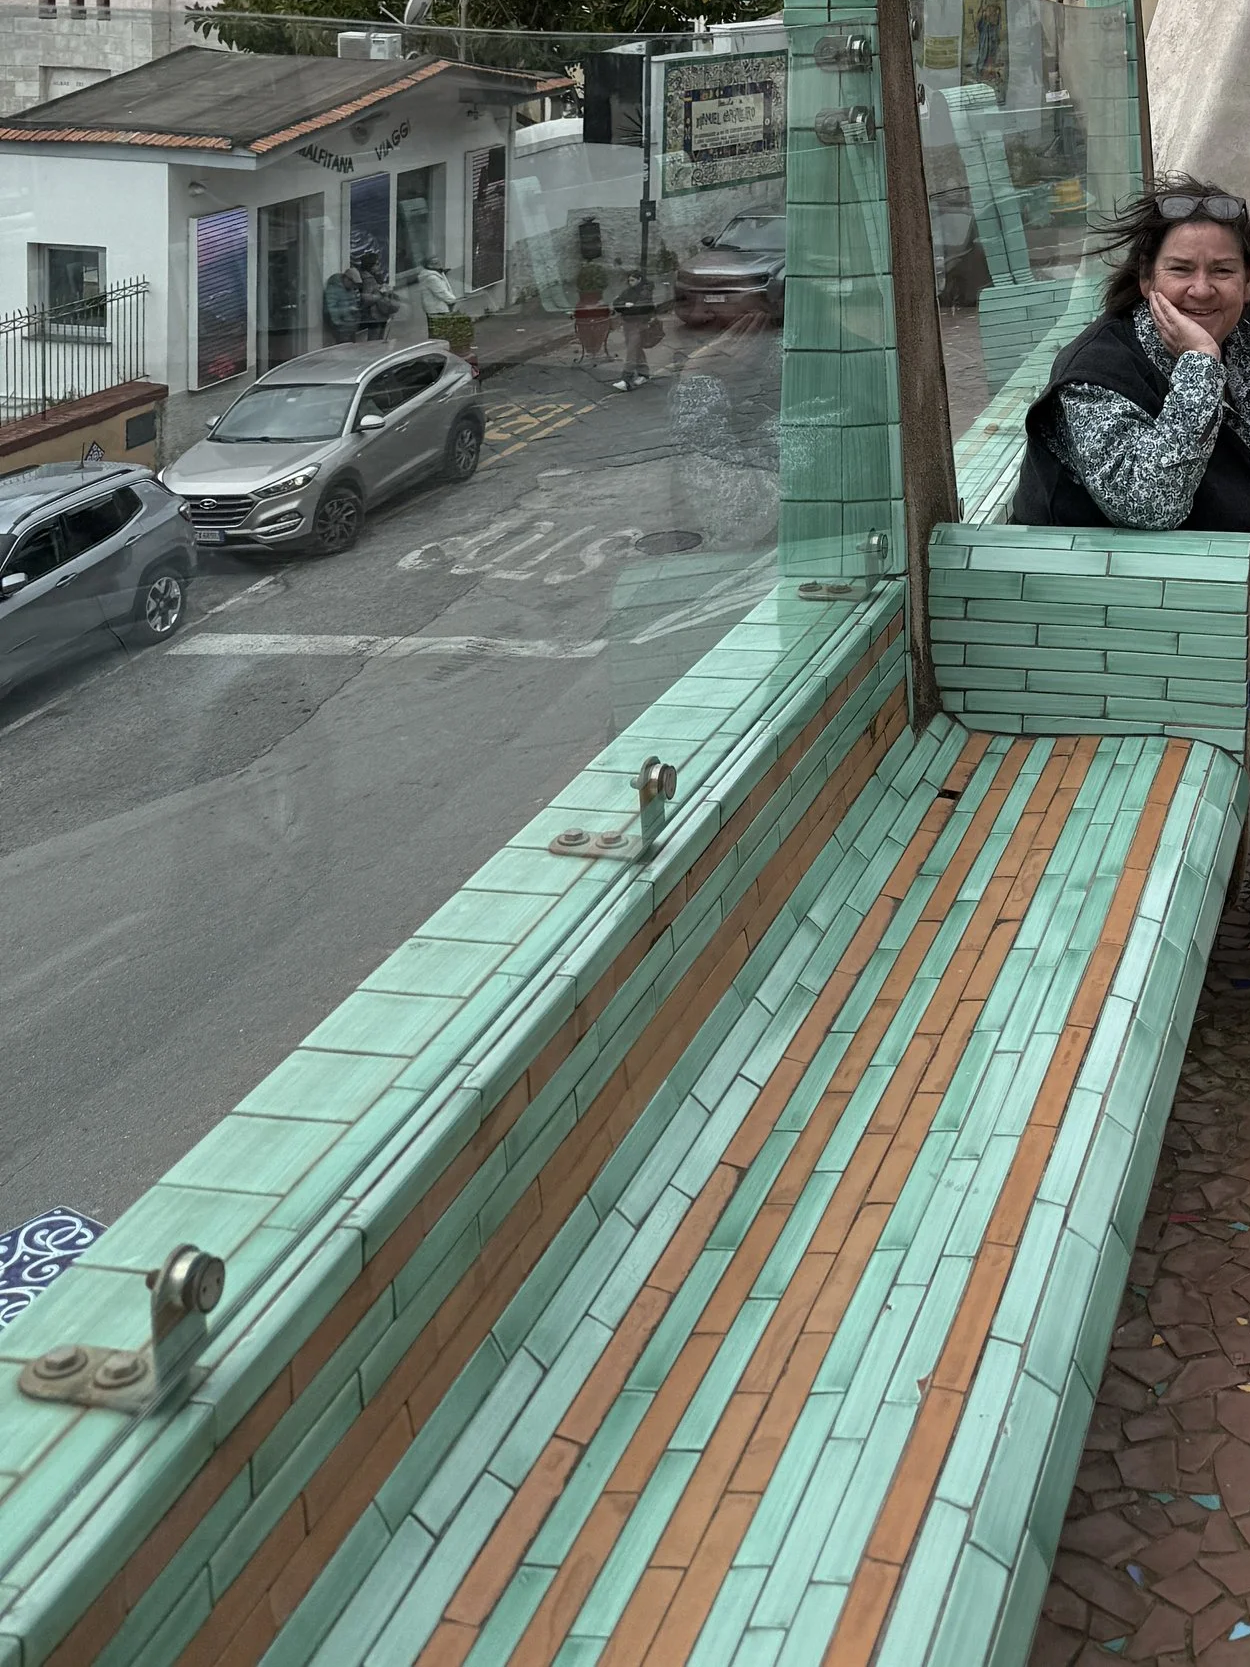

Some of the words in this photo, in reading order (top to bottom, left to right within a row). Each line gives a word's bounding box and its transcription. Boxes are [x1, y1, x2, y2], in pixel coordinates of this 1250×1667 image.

[298, 143, 354, 174] ALFITANA
[375, 118, 411, 161] VIAGGI
[397, 520, 645, 584] STOP
